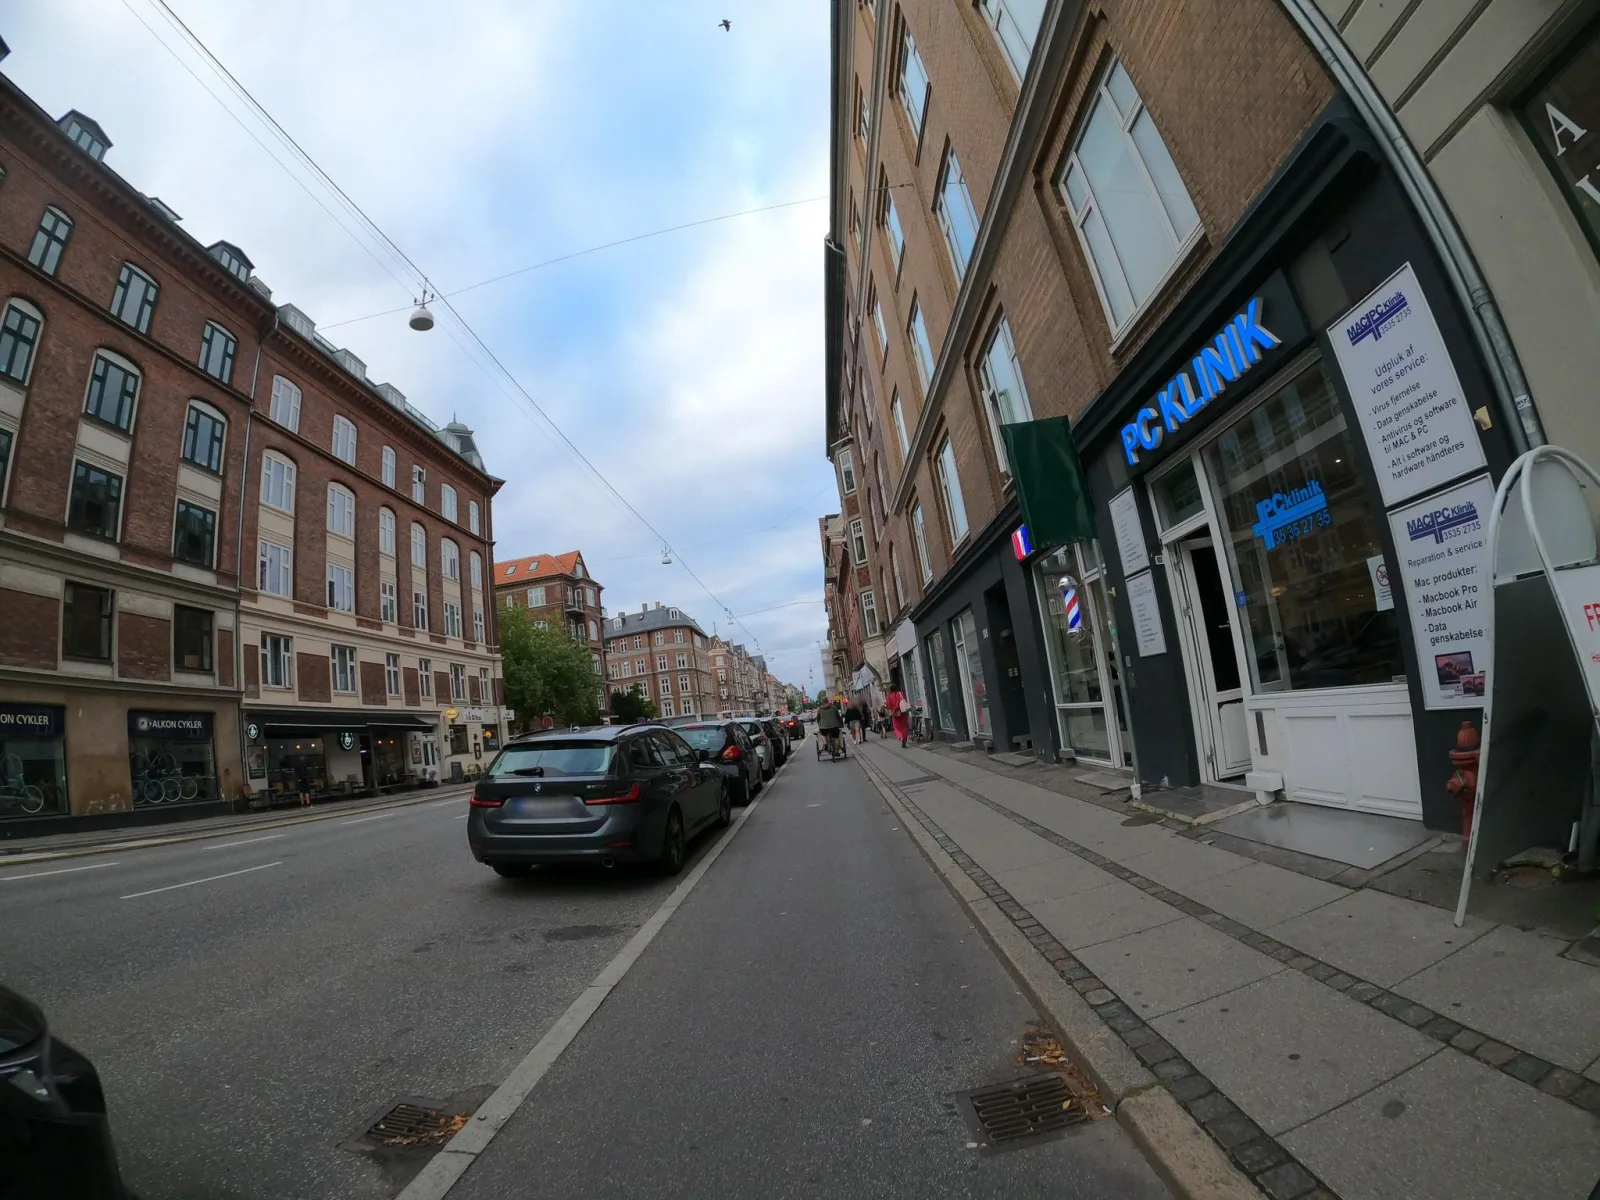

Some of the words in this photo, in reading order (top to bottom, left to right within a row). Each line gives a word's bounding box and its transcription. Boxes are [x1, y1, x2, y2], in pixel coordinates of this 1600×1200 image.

[1381, 319, 1396, 334] 3535
[1395, 306, 1412, 323] 2735
[1371, 376, 1394, 395] vores
[1395, 353, 1428, 380] service:
[1374, 354, 1405, 377] Udpluk
[1405, 344, 1415, 358] af
[1121, 407, 1162, 465] PC
[1157, 296, 1282, 433] KLINIK
[1372, 401, 1390, 416] Virus
[1390, 381, 1421, 406] fjernelse
[1376, 416, 1393, 430] Data
[1393, 389, 1438, 422] genskabelse
[1381, 421, 1412, 444] Antivirus
[1413, 416, 1424, 427] og
[1424, 397, 1457, 420] software
[1384, 443, 1392, 454] til
[1392, 434, 1409, 450] MAC
[1411, 431, 1417, 441] &
[1417, 425, 1429, 437] PC
[1391, 455, 1402, 469] Alt
[1406, 440, 1437, 462] software
[1438, 434, 1450, 446] og
[1392, 459, 1425, 480] hardware
[1274, 529, 1287, 545] 35
[1287, 522, 1301, 540] 35
[1301, 516, 1314, 534] 27
[1316, 509, 1331, 527] 35
[1443, 527, 1461, 540] 3535
[1462, 521, 1481, 535] 2735
[1408, 551, 1446, 568] Reparation
[1447, 547, 1453, 557] &
[1454, 539, 1482, 555] service
[1414, 578, 1431, 588] Mac
[1433, 565, 1478, 586] produkter:
[1422, 586, 1460, 604] Macbook
[1461, 584, 1478, 596] Pro
[1425, 601, 1463, 618] Macbook
[1465, 599, 1478, 610] Air
[1428, 622, 1447, 633] Data
[1430, 628, 1484, 647] genskabelse
[16, 714, 49, 725] CYKLER
[177, 720, 202, 728] CYKLER
